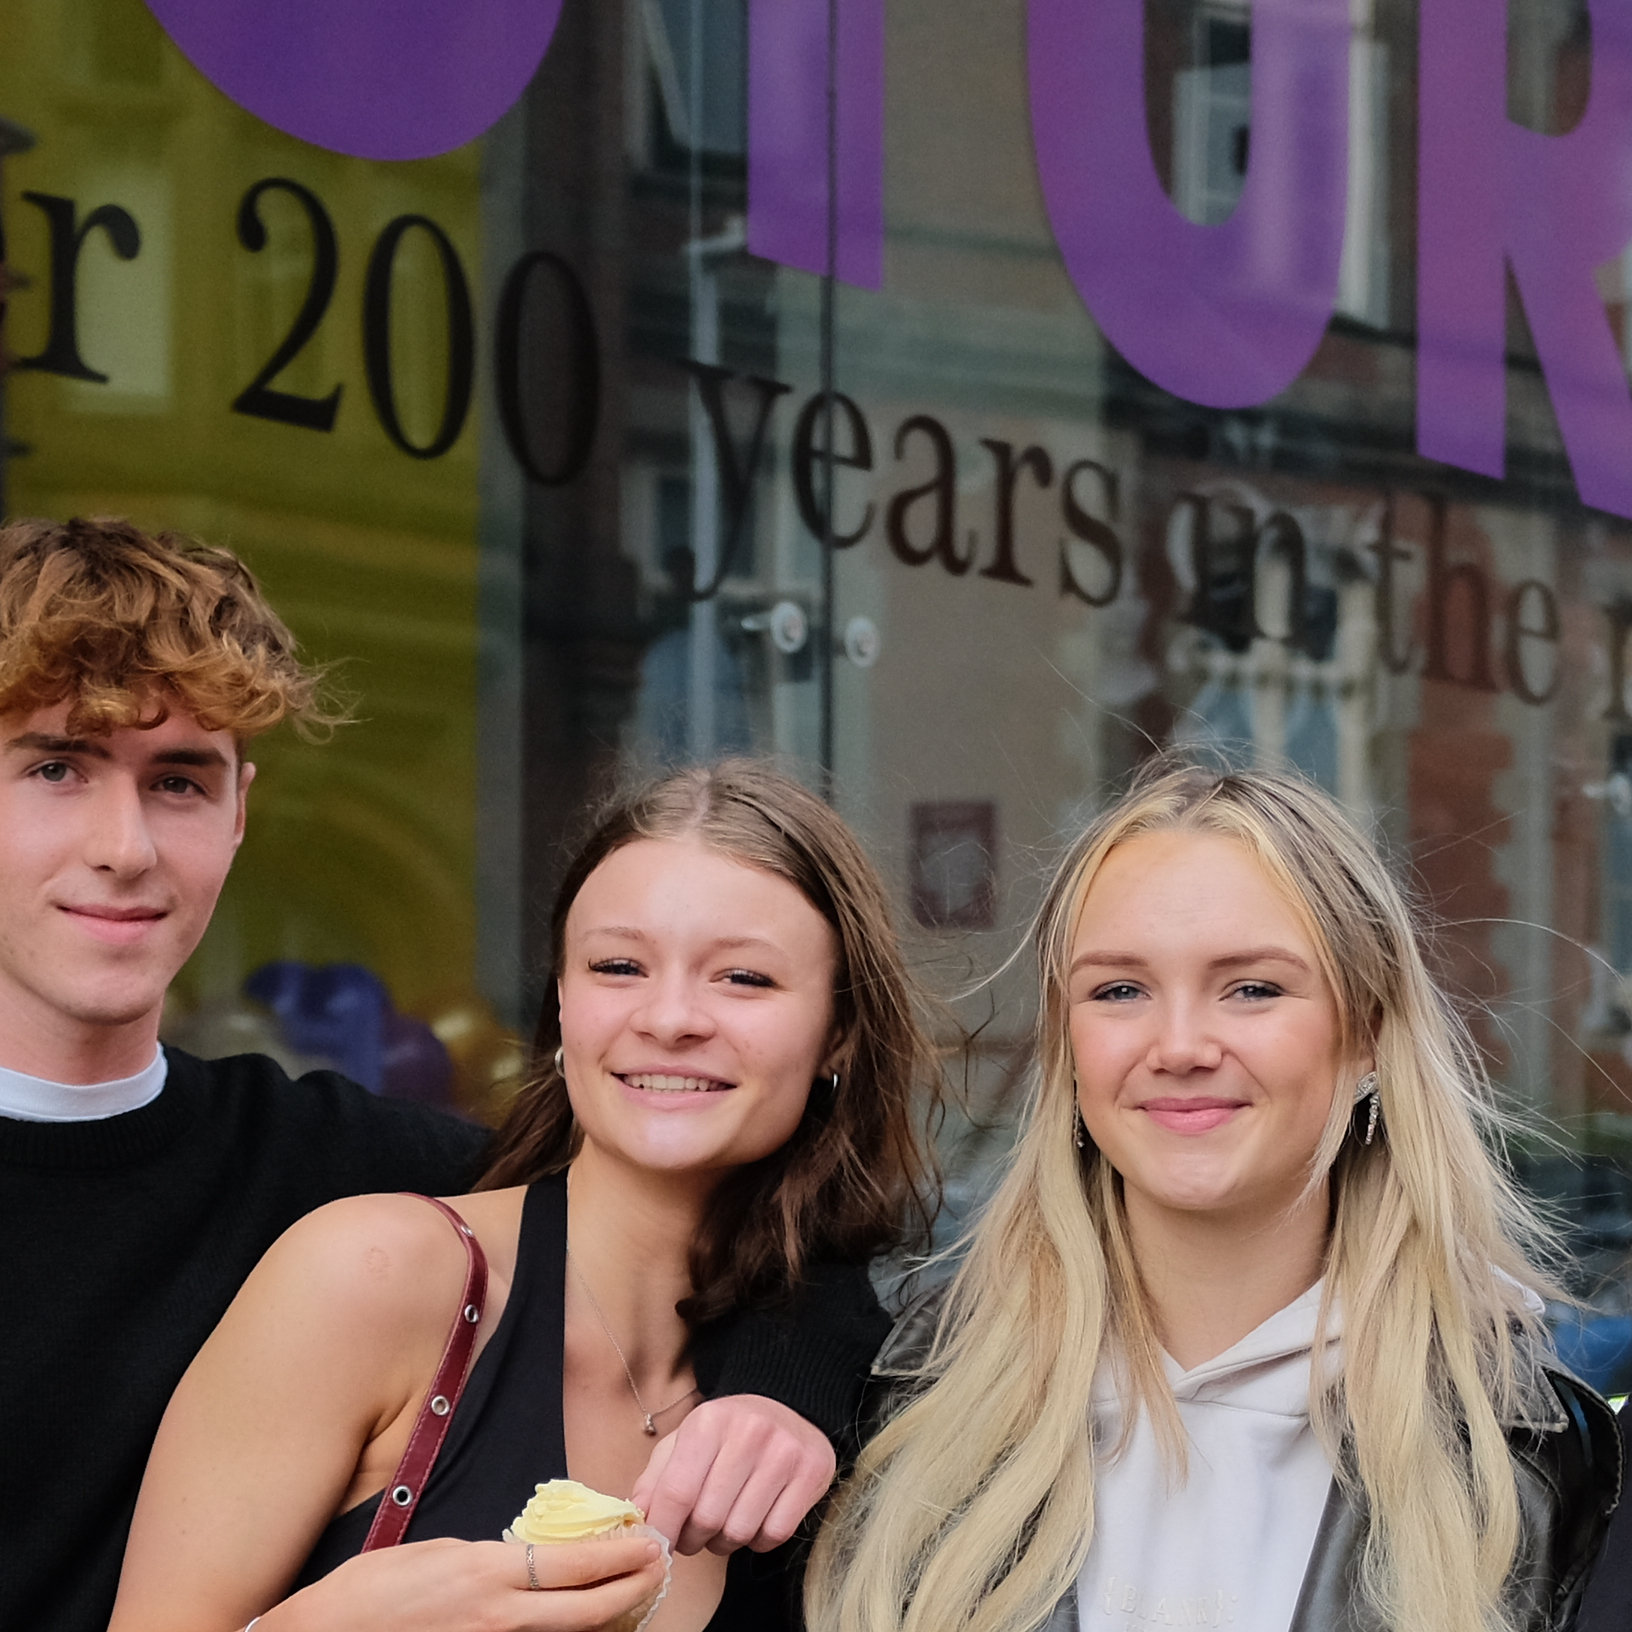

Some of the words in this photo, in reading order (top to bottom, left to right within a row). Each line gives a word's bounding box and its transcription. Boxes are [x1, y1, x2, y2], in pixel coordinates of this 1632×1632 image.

[231, 175, 602, 487] 200
[671, 356, 1124, 608] years
[1367, 490, 1560, 706] the
